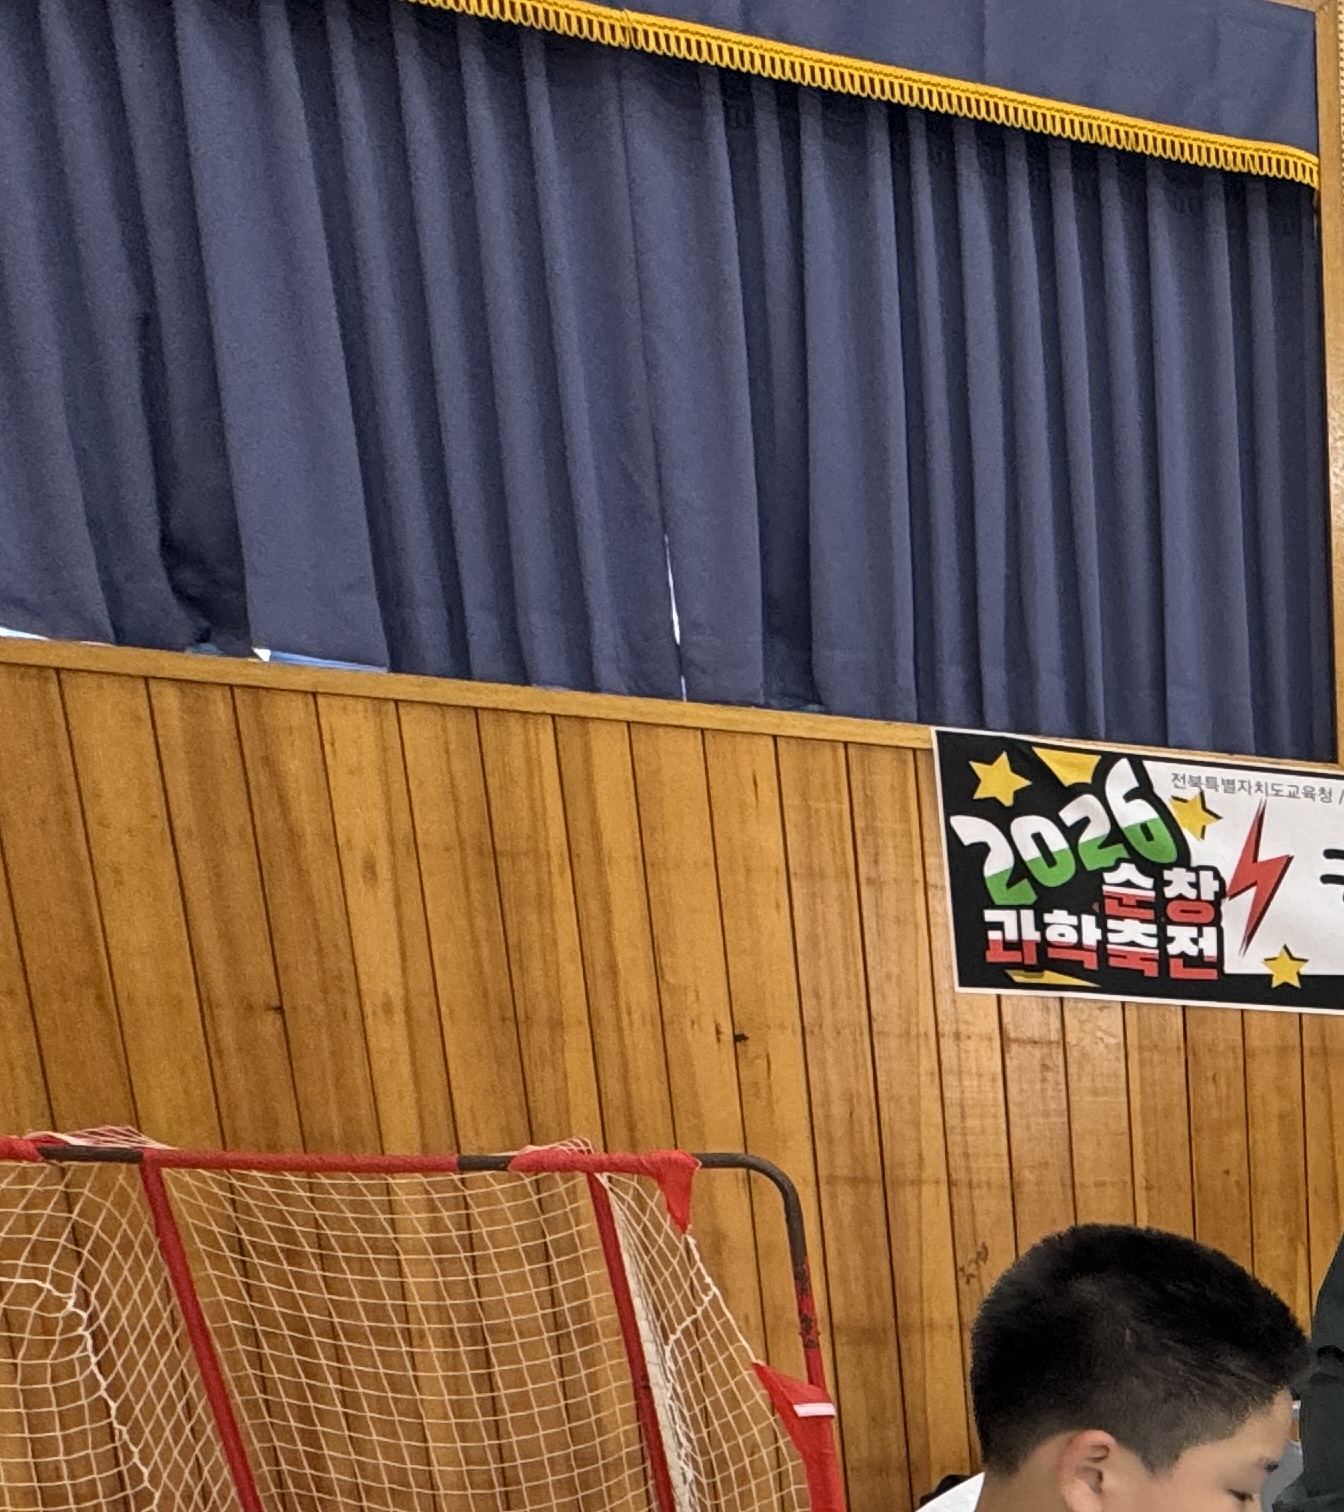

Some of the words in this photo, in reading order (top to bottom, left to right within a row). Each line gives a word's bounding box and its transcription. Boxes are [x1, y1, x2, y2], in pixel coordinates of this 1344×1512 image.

[1171, 772, 1333, 804] 전북특별자치도교육청
[949, 758, 1179, 906] 2026
[1101, 863, 1224, 924] 순창
[983, 906, 1223, 980] 과학축전
